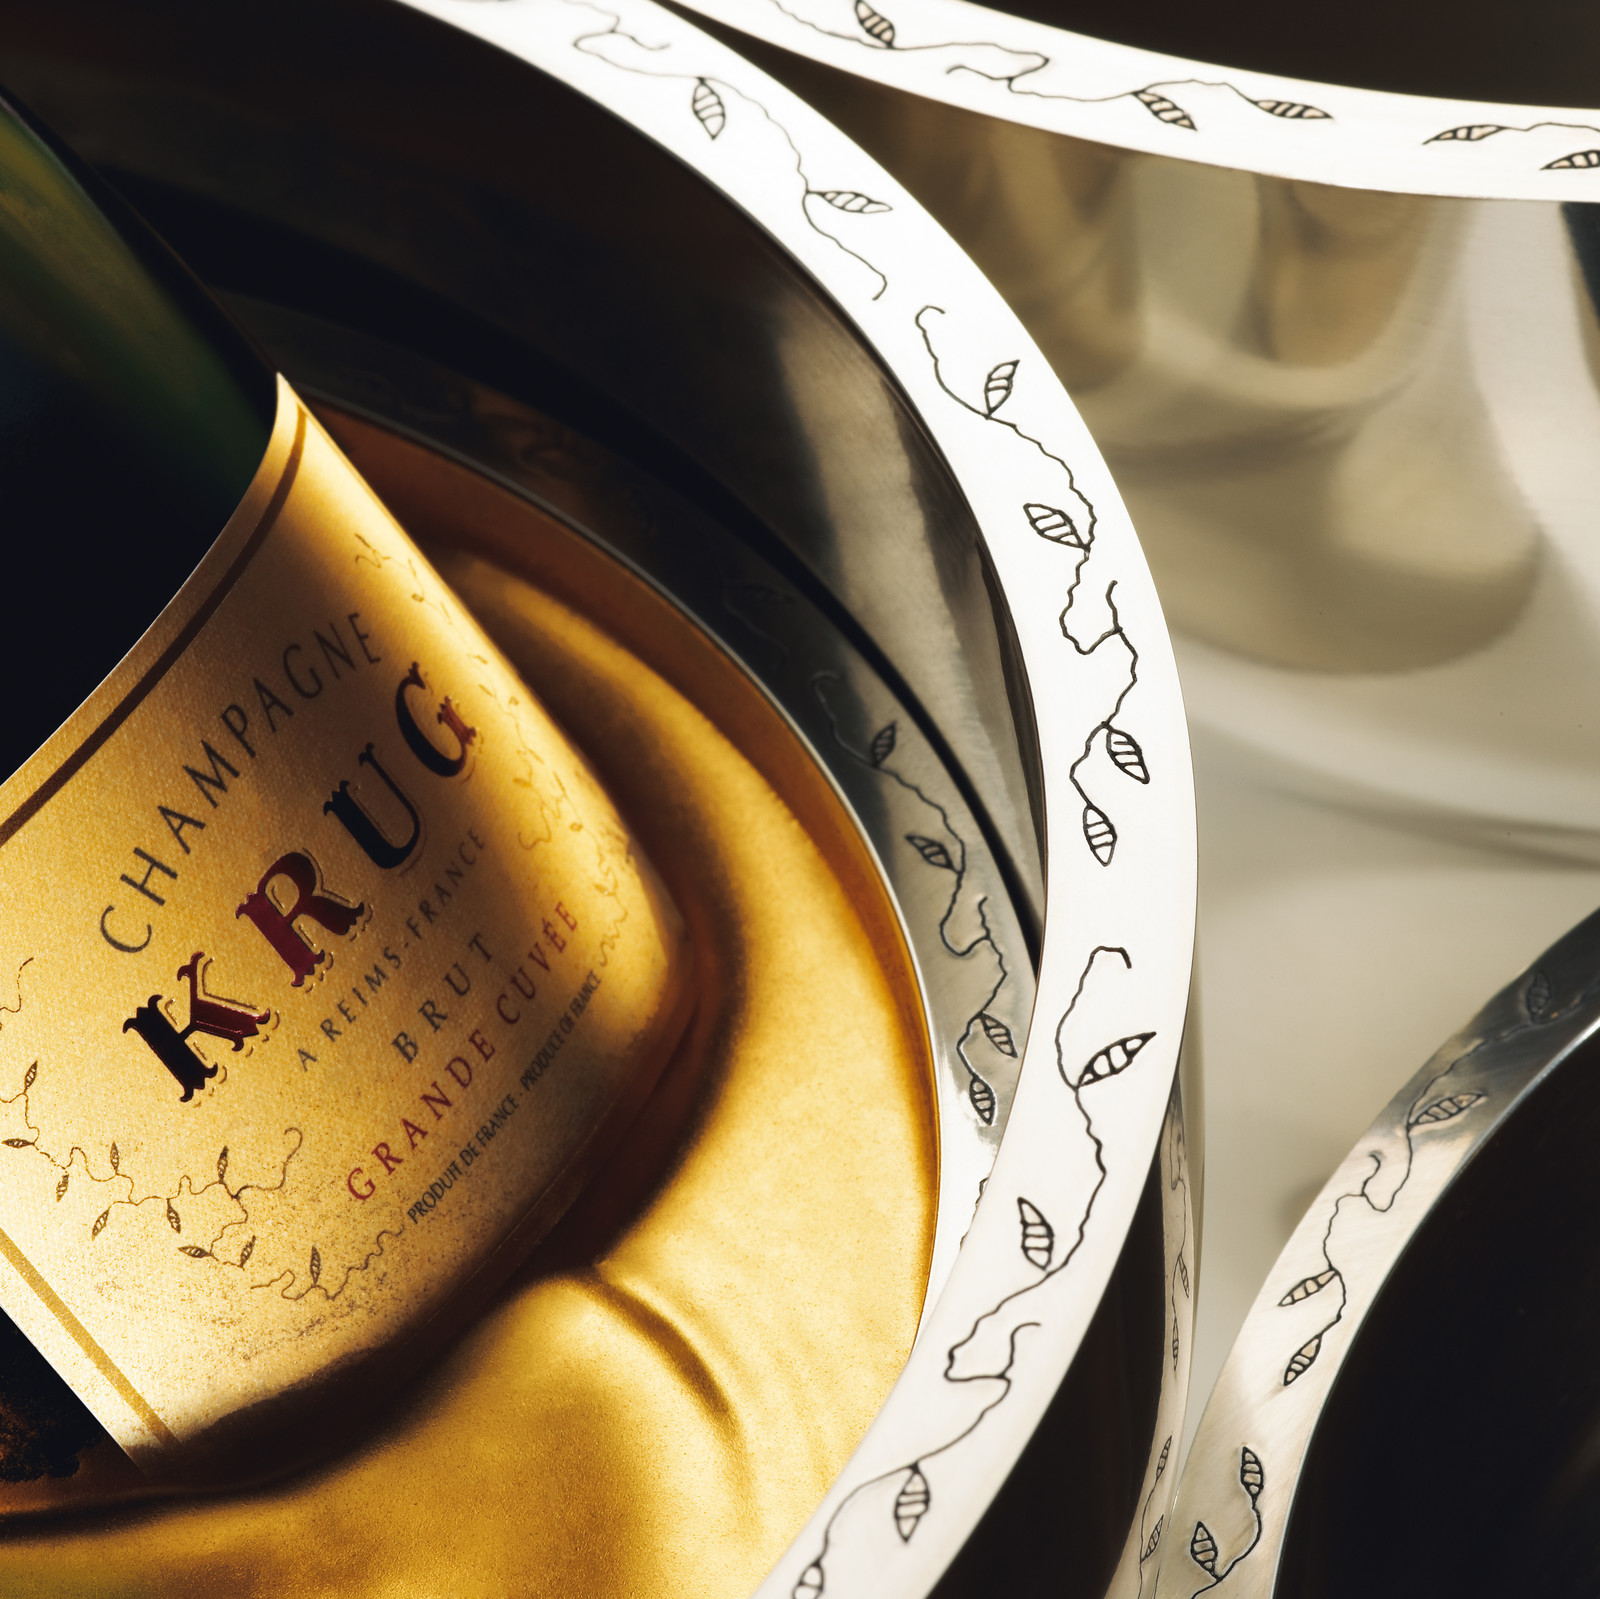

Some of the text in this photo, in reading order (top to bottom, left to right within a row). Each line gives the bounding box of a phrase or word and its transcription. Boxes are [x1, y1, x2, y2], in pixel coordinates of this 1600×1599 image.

[100, 612, 382, 954] CHAMPAGNE
[122, 661, 477, 1103] KRUG
[297, 1047, 318, 1072] A
[347, 901, 579, 1202] GRANDE CUVÉE
[391, 931, 493, 1064] BRUT
[407, 969, 602, 1225] PRODUIT DE FRANCE PRODUCE OF FRANCE
